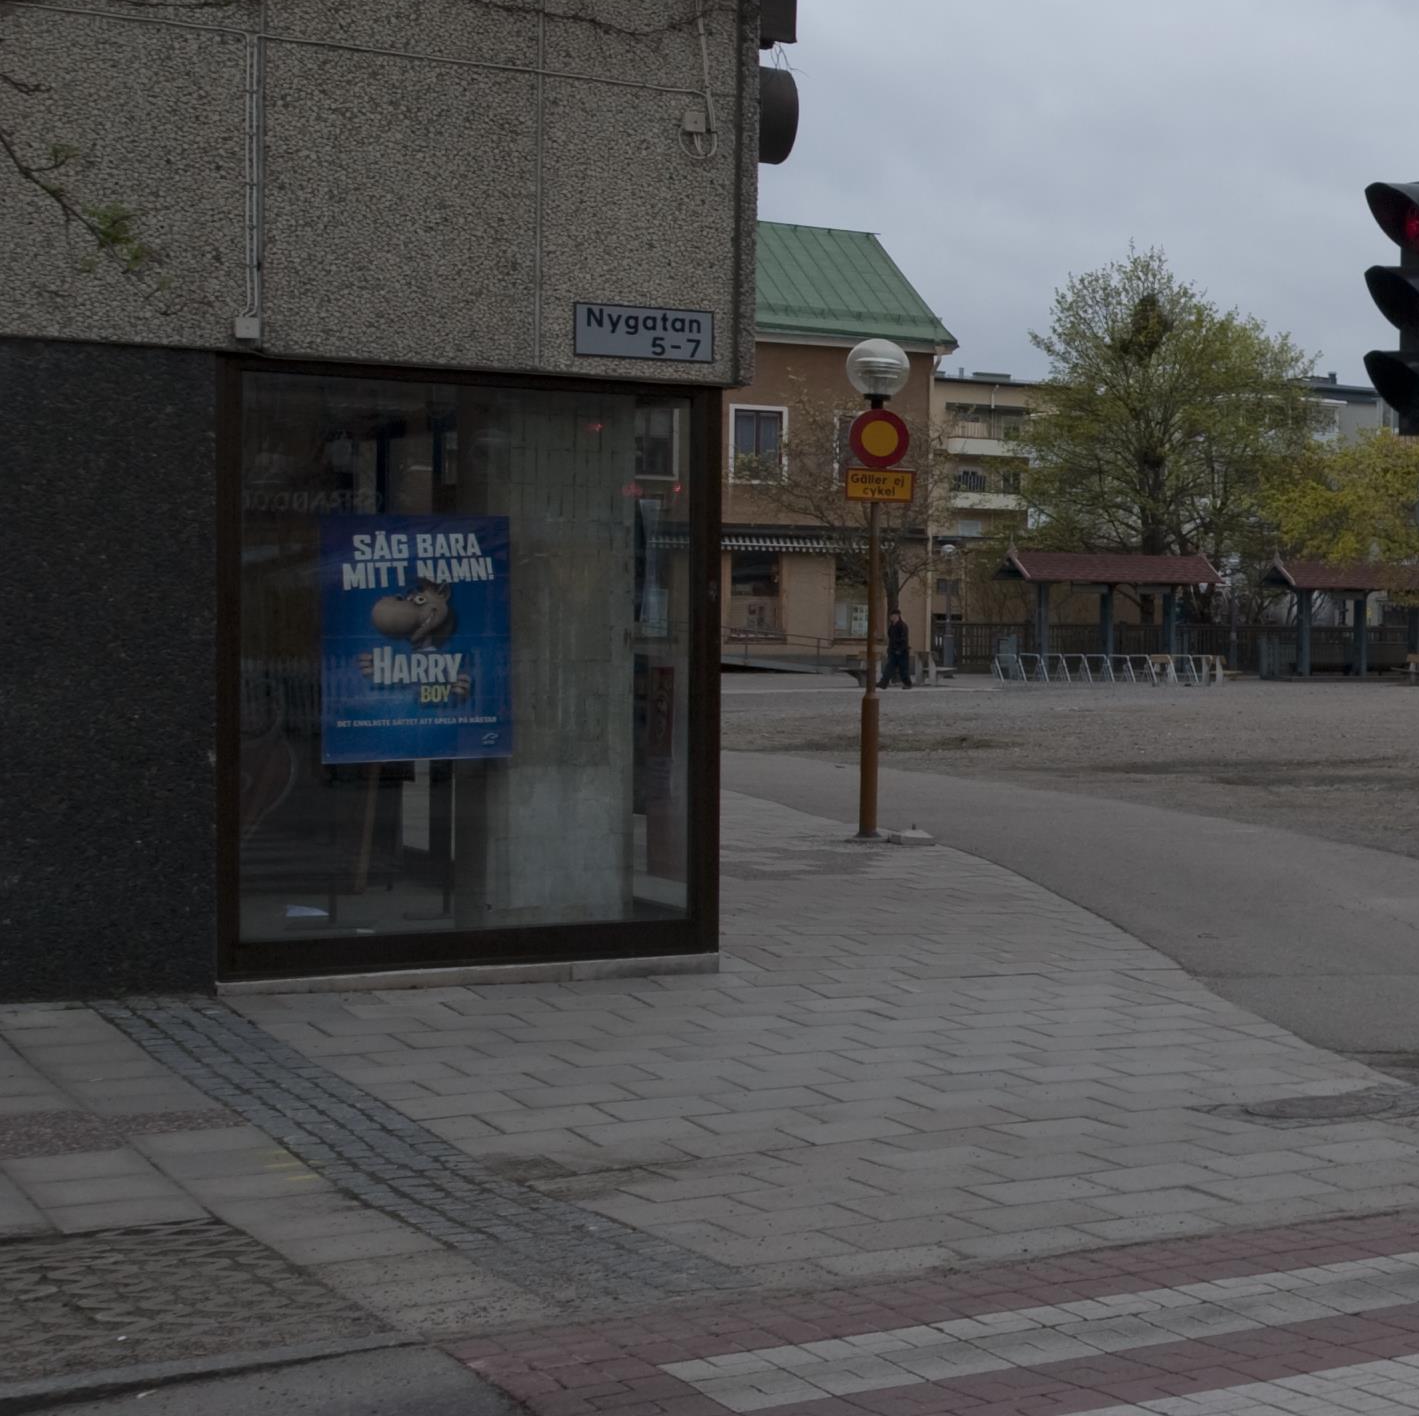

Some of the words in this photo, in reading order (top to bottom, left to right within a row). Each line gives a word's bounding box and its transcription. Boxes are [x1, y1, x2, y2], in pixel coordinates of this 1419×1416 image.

[586, 307, 701, 334] Nygatan
[651, 337, 701, 358] 5-7
[850, 473, 887, 485] Gäller
[894, 475, 905, 488] ej
[862, 485, 896, 497] cykel
[353, 531, 410, 561] SÄG
[416, 532, 482, 558] BARA
[342, 561, 408, 591] MITT
[416, 557, 495, 584] NAMN!
[372, 646, 463, 684] HARRY
[420, 684, 451, 703] BOY
